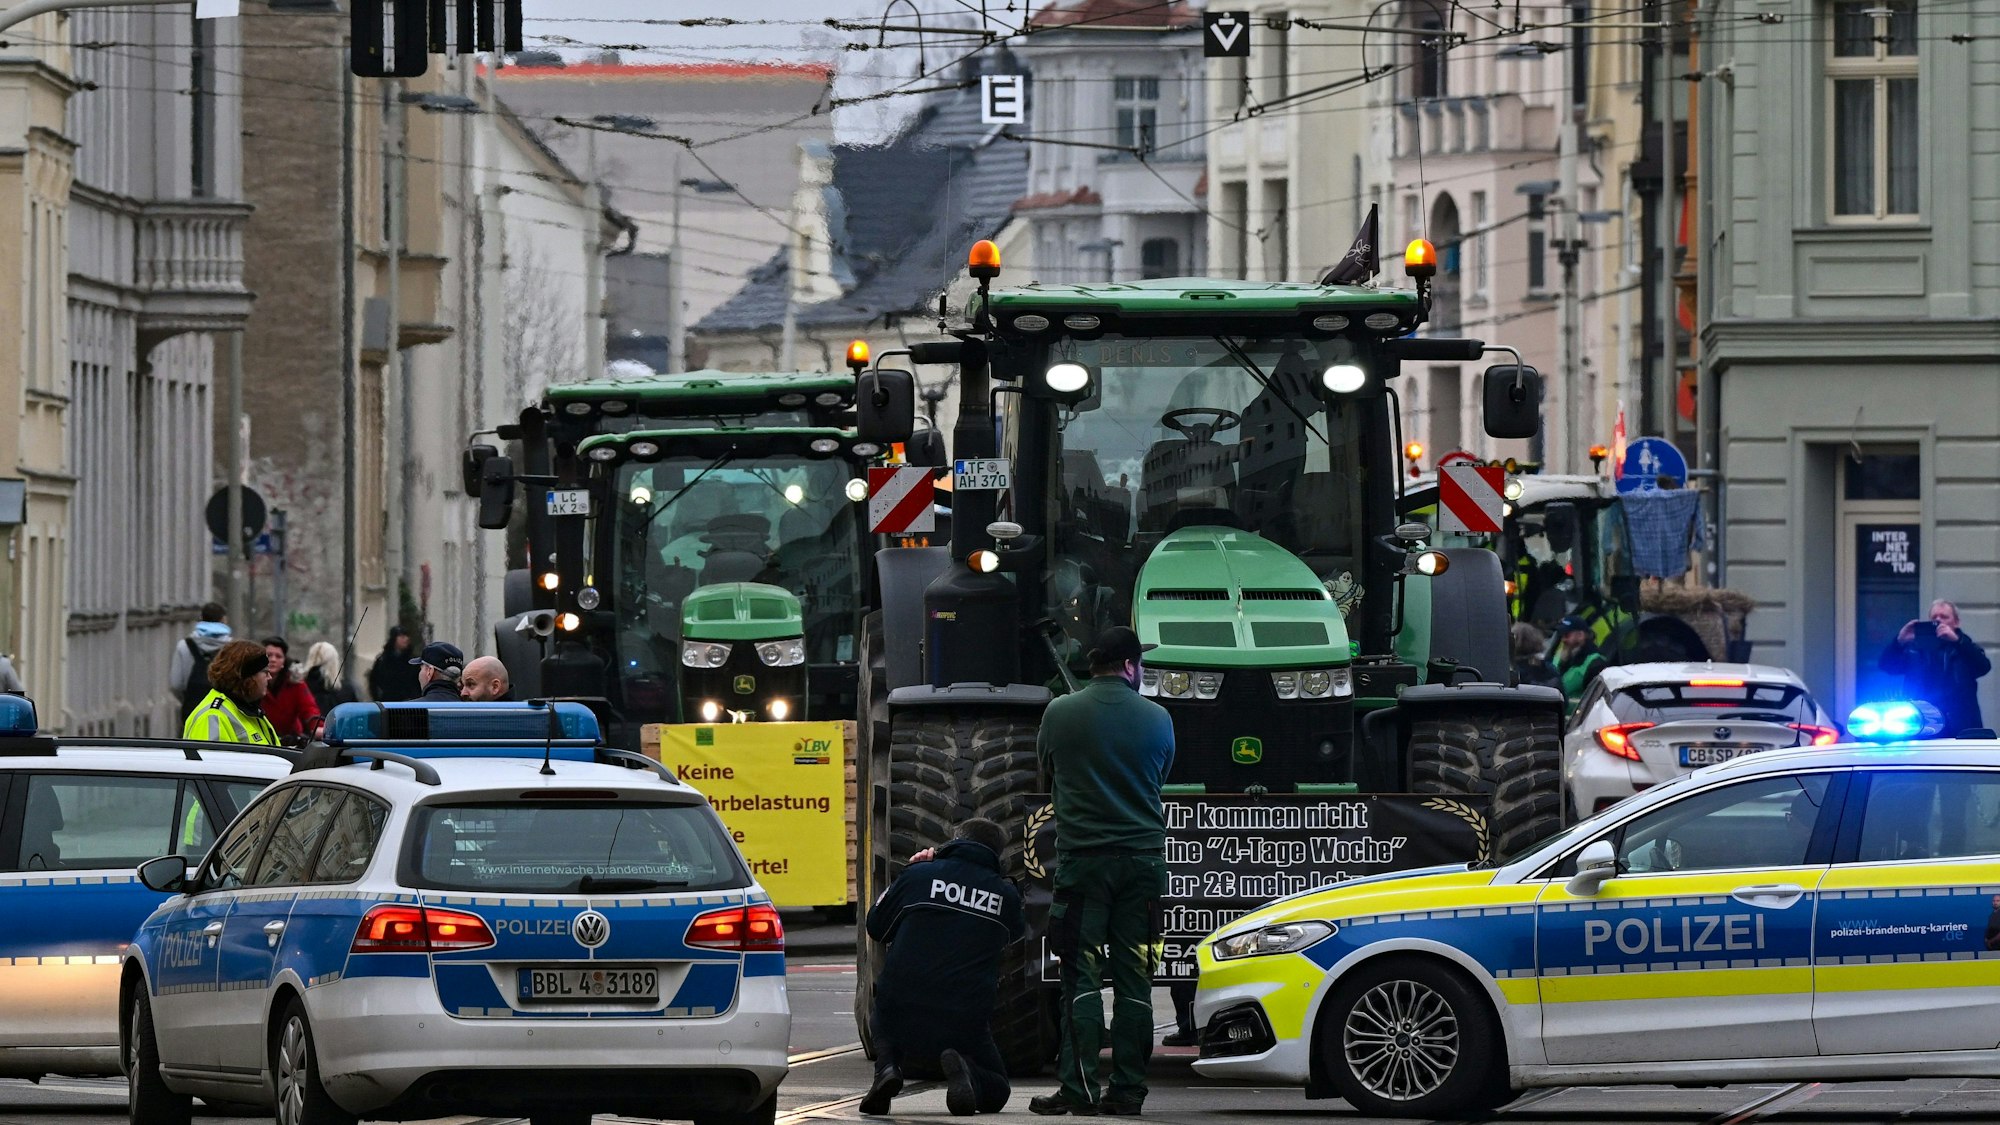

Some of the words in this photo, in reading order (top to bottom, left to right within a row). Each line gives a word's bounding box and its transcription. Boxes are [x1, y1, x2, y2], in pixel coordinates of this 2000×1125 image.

[989, 82, 1017, 117] E
[968, 461, 985, 474] TF
[959, 475, 977, 488] AH
[981, 474, 1007, 488] 370
[561, 492, 577, 503] LC
[552, 504, 566, 514] AK
[570, 503, 578, 513] 2
[1871, 531, 1907, 542] INTER
[1885, 541, 1910, 552] NET
[1874, 551, 1908, 562] AGEN
[1891, 562, 1916, 573] TUR
[1688, 749, 1707, 762] CB
[1715, 749, 1734, 762] SP
[677, 764, 735, 780] Keine
[1197, 802, 1301, 829] kommen
[1305, 802, 1369, 829] nicht
[477, 864, 689, 876] www.internetwache.brandenburg.de
[1203, 871, 1236, 898] 2€
[1240, 871, 1307, 898] mehr
[930, 879, 1003, 916] POLIZEI
[495, 919, 571, 936] POLIZEI
[1584, 913, 1765, 956] POLIZEI
[1830, 922, 1968, 939] polizei-brandenburg-karriere
[164, 929, 204, 969] POLIZEI
[1171, 961, 1195, 976] für
[533, 972, 572, 995] BBL
[579, 972, 591, 995] 4
[605, 972, 656, 995] 3189
